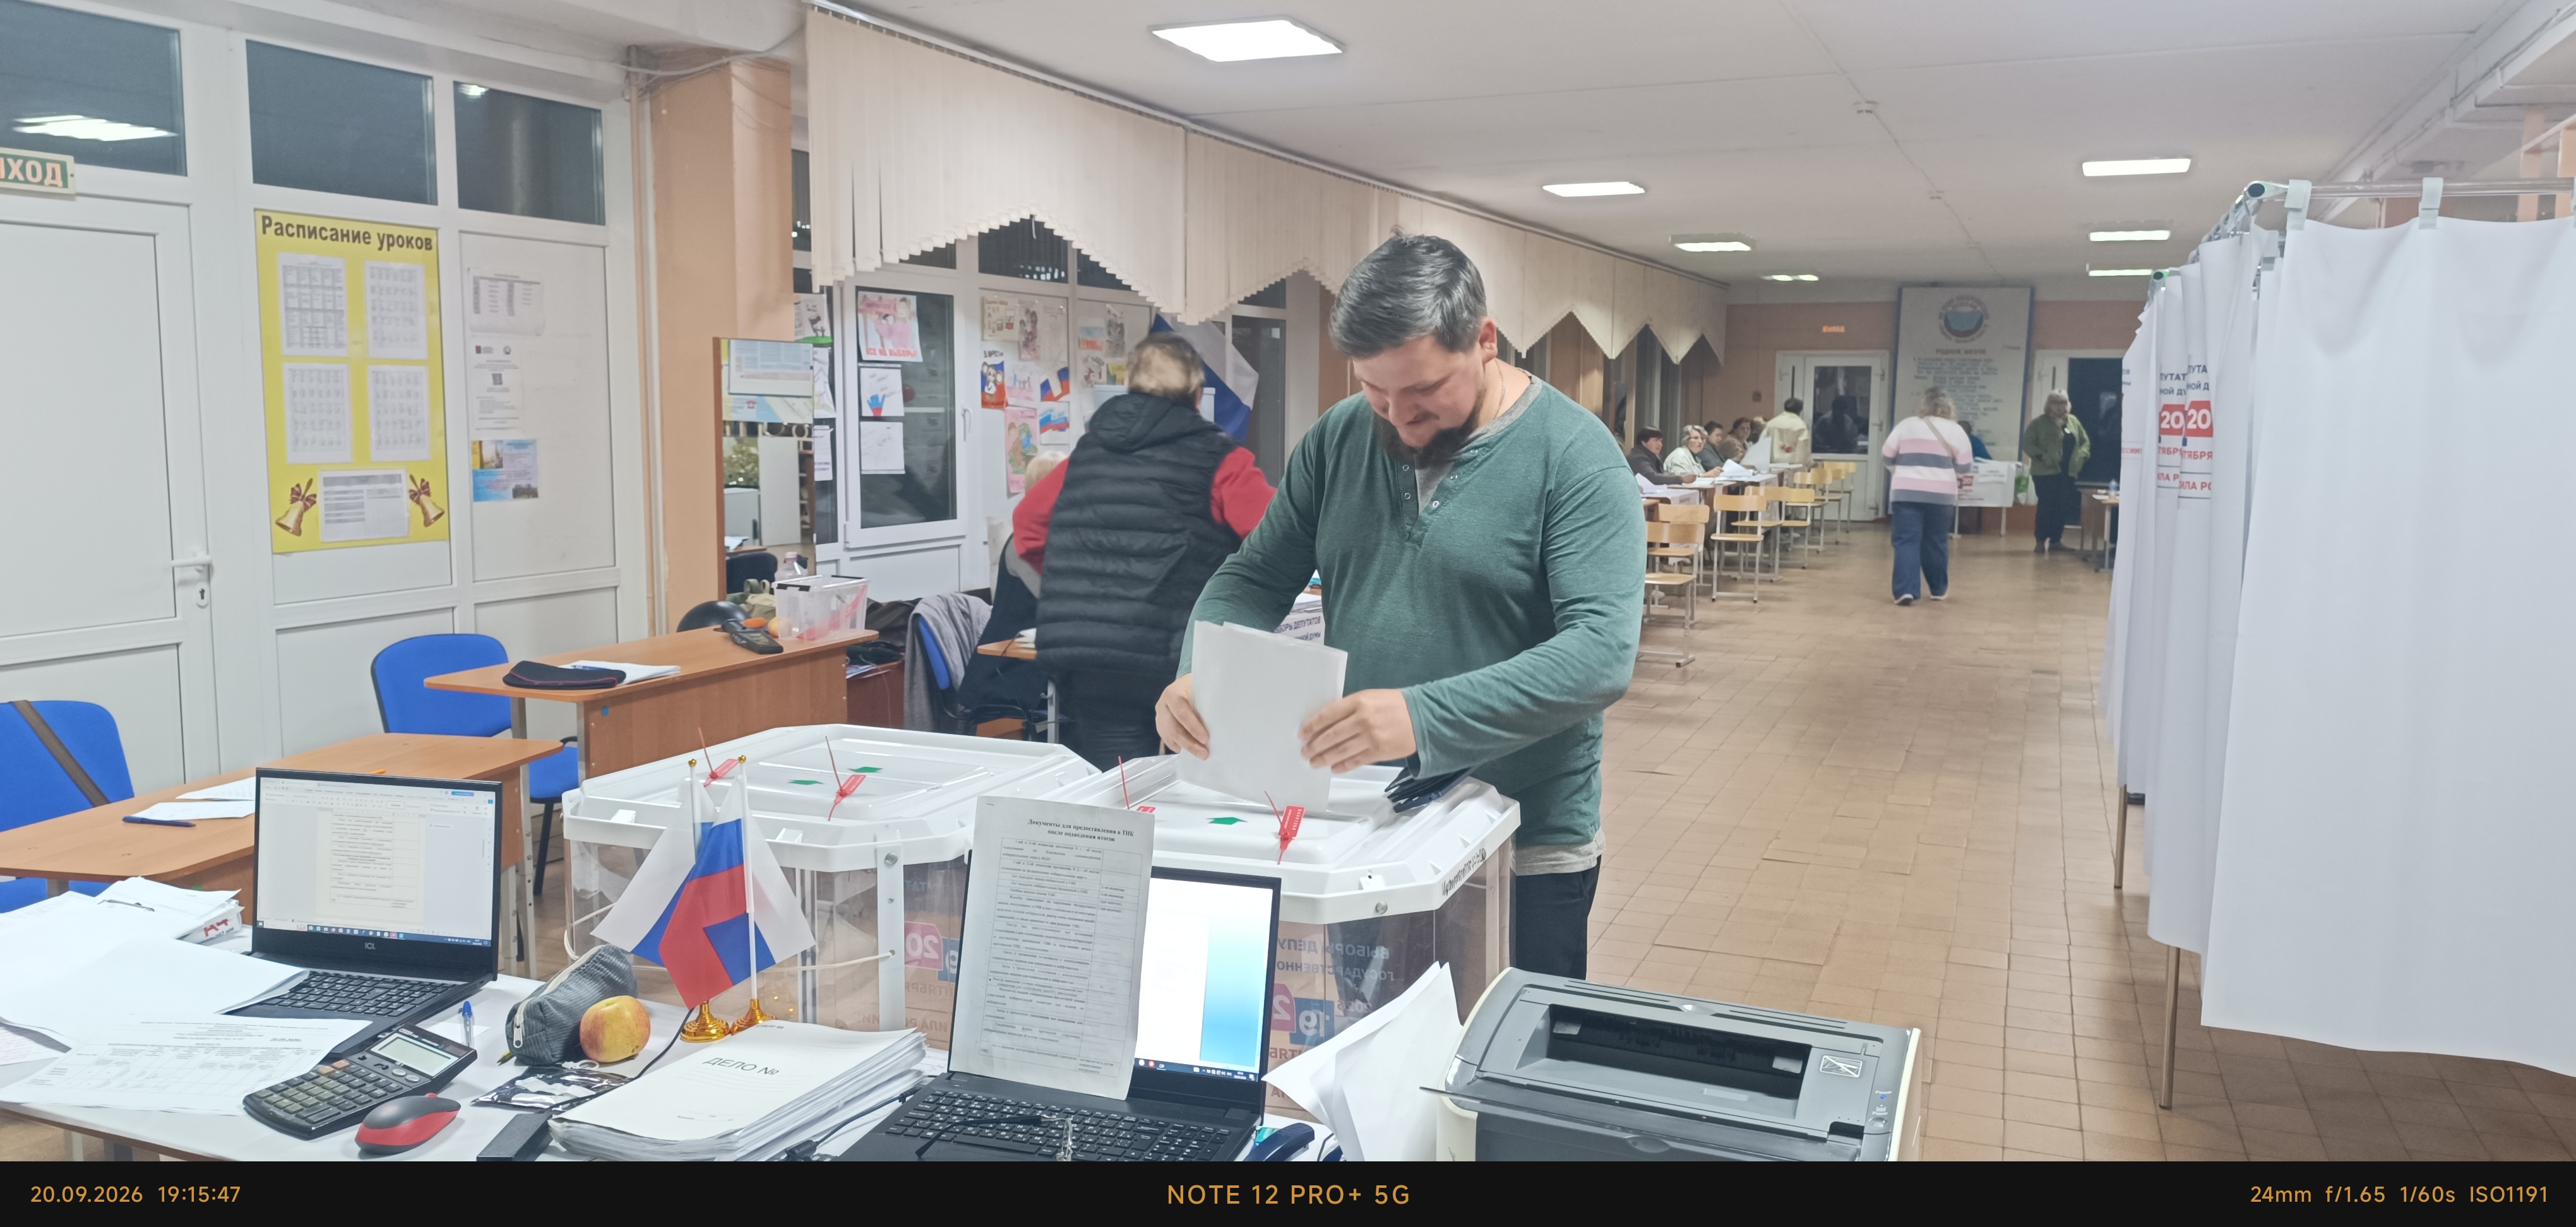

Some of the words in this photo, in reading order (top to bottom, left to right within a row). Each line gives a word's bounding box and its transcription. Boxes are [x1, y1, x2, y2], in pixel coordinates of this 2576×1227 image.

[0, 157, 63, 187] ХОД
[261, 215, 371, 244] Расписание
[377, 232, 433, 252] уроков
[2161, 410, 2185, 429] 20
[2186, 408, 2212, 429] 20
[1027, 819, 1060, 827] Документы
[1073, 825, 1116, 834] предоставления
[1064, 831, 1096, 839] подведения
[365, 942, 376, 950] ICL
[702, 1057, 757, 1071] ДЕЛО
[757, 1067, 779, 1076] №
